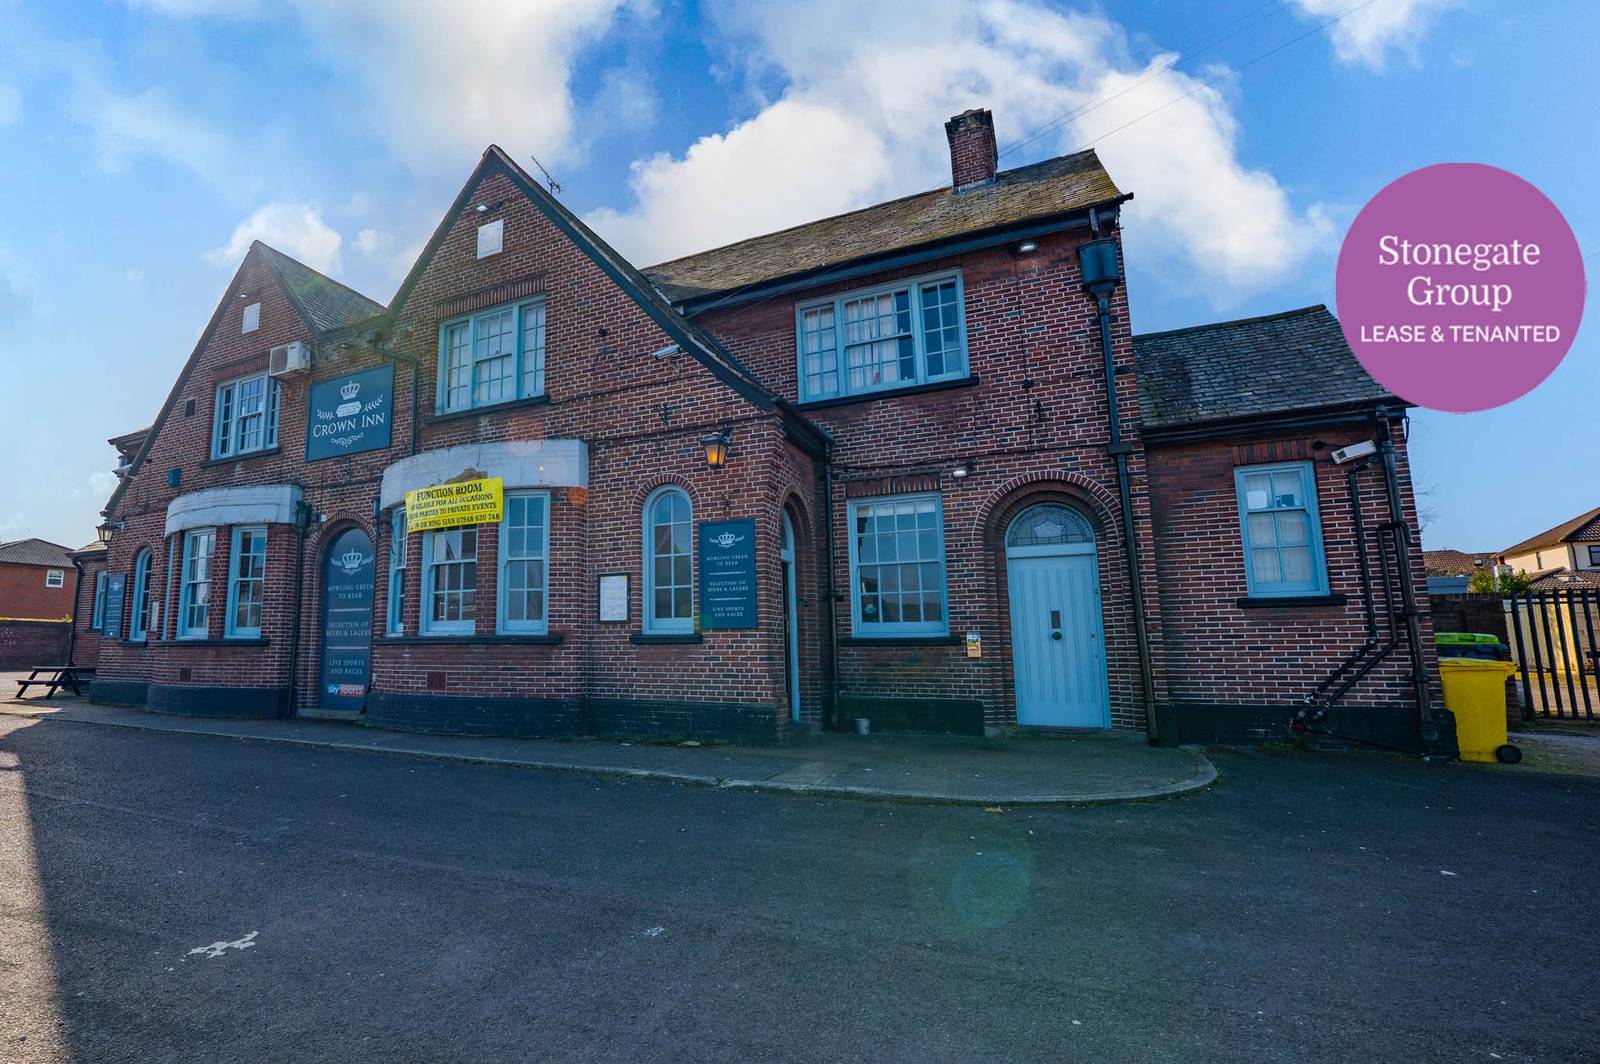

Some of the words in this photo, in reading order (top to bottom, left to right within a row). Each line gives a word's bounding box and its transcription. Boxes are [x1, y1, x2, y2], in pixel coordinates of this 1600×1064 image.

[313, 418, 357, 438] CROWN
[362, 412, 385, 428] INN
[416, 487, 454, 501] FUNCTION
[456, 483, 482, 495] ROOM
[435, 499, 447, 507] FOR
[460, 493, 493, 504] OCCASIONS
[419, 508, 439, 518] PARTIES
[447, 504, 471, 514] PRIVATE
[472, 502, 497, 511] EVENTS
[442, 517, 456, 526] SIAN
[328, 684, 339, 695] sky
